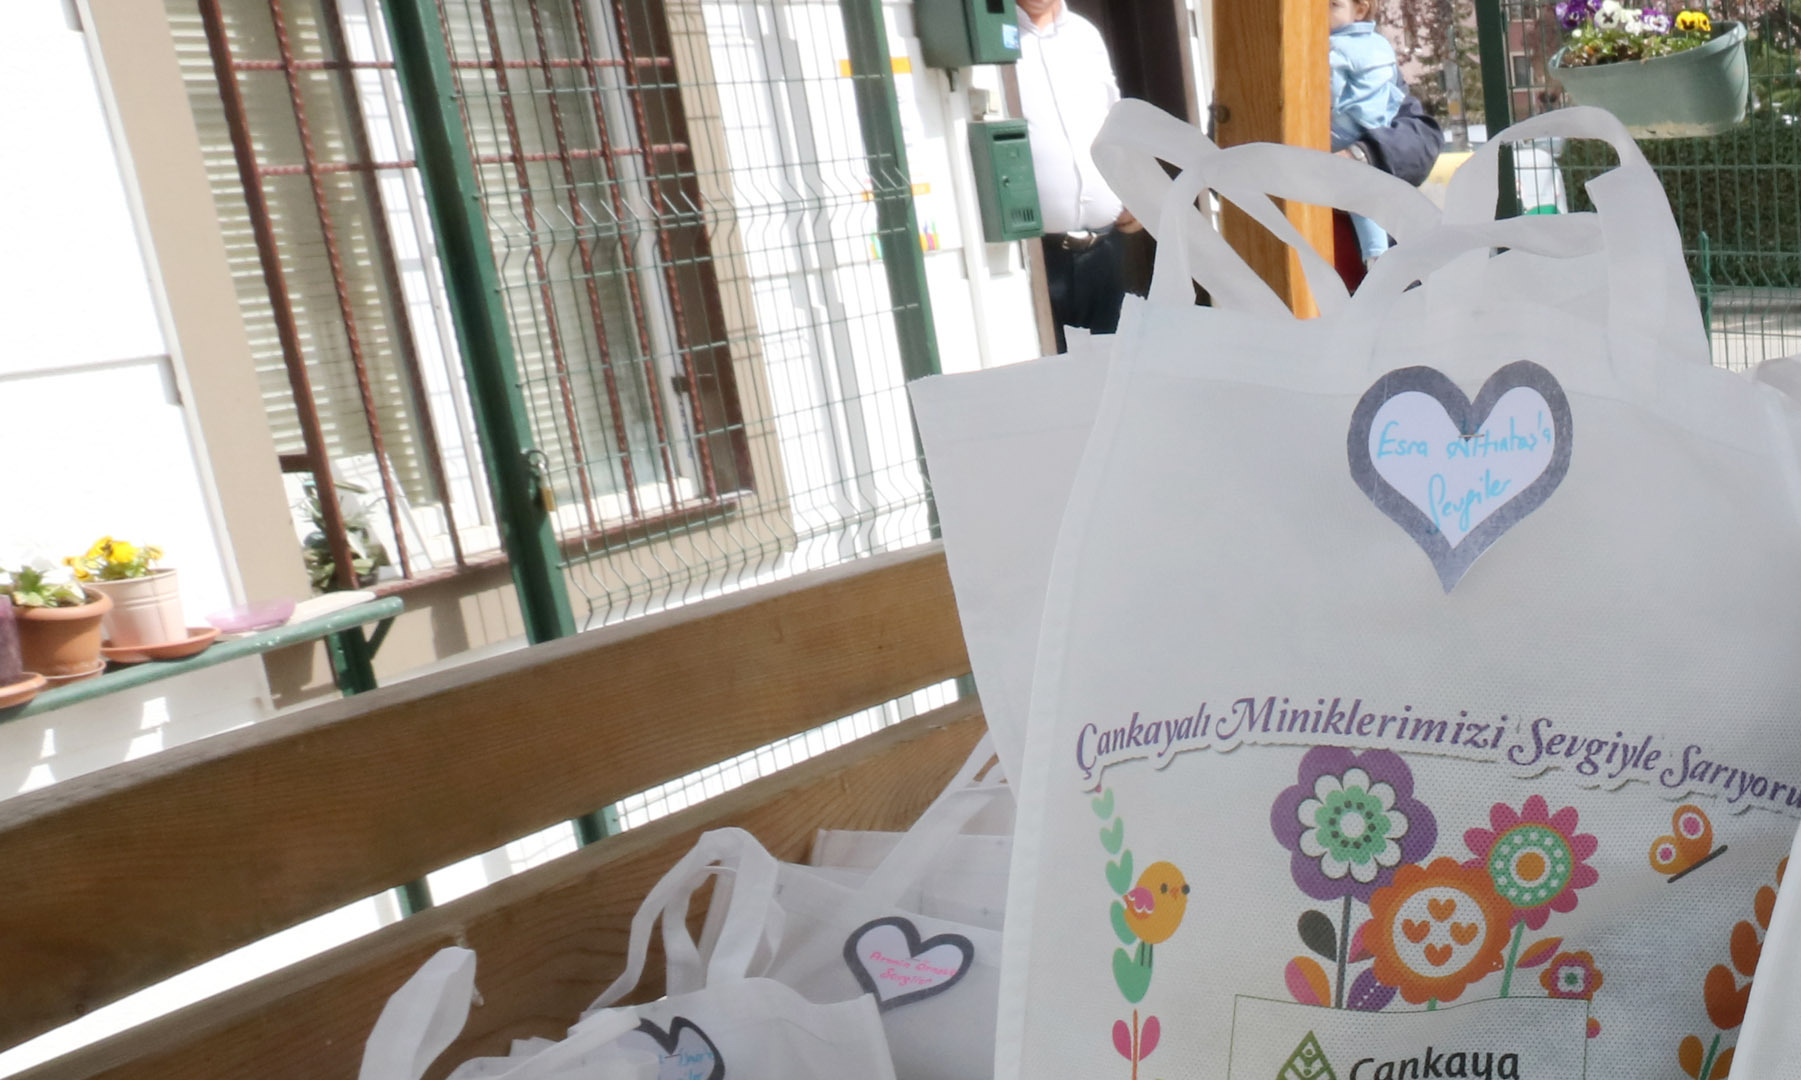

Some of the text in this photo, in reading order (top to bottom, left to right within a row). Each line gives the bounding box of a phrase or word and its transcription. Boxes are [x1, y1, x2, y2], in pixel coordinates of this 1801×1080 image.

[1376, 420, 1428, 460] Esra
[1076, 702, 1211, 780] Çankayalı
[1215, 696, 1508, 750] Miniklerimizi
[1508, 718, 1661, 779] Sevgiyle
